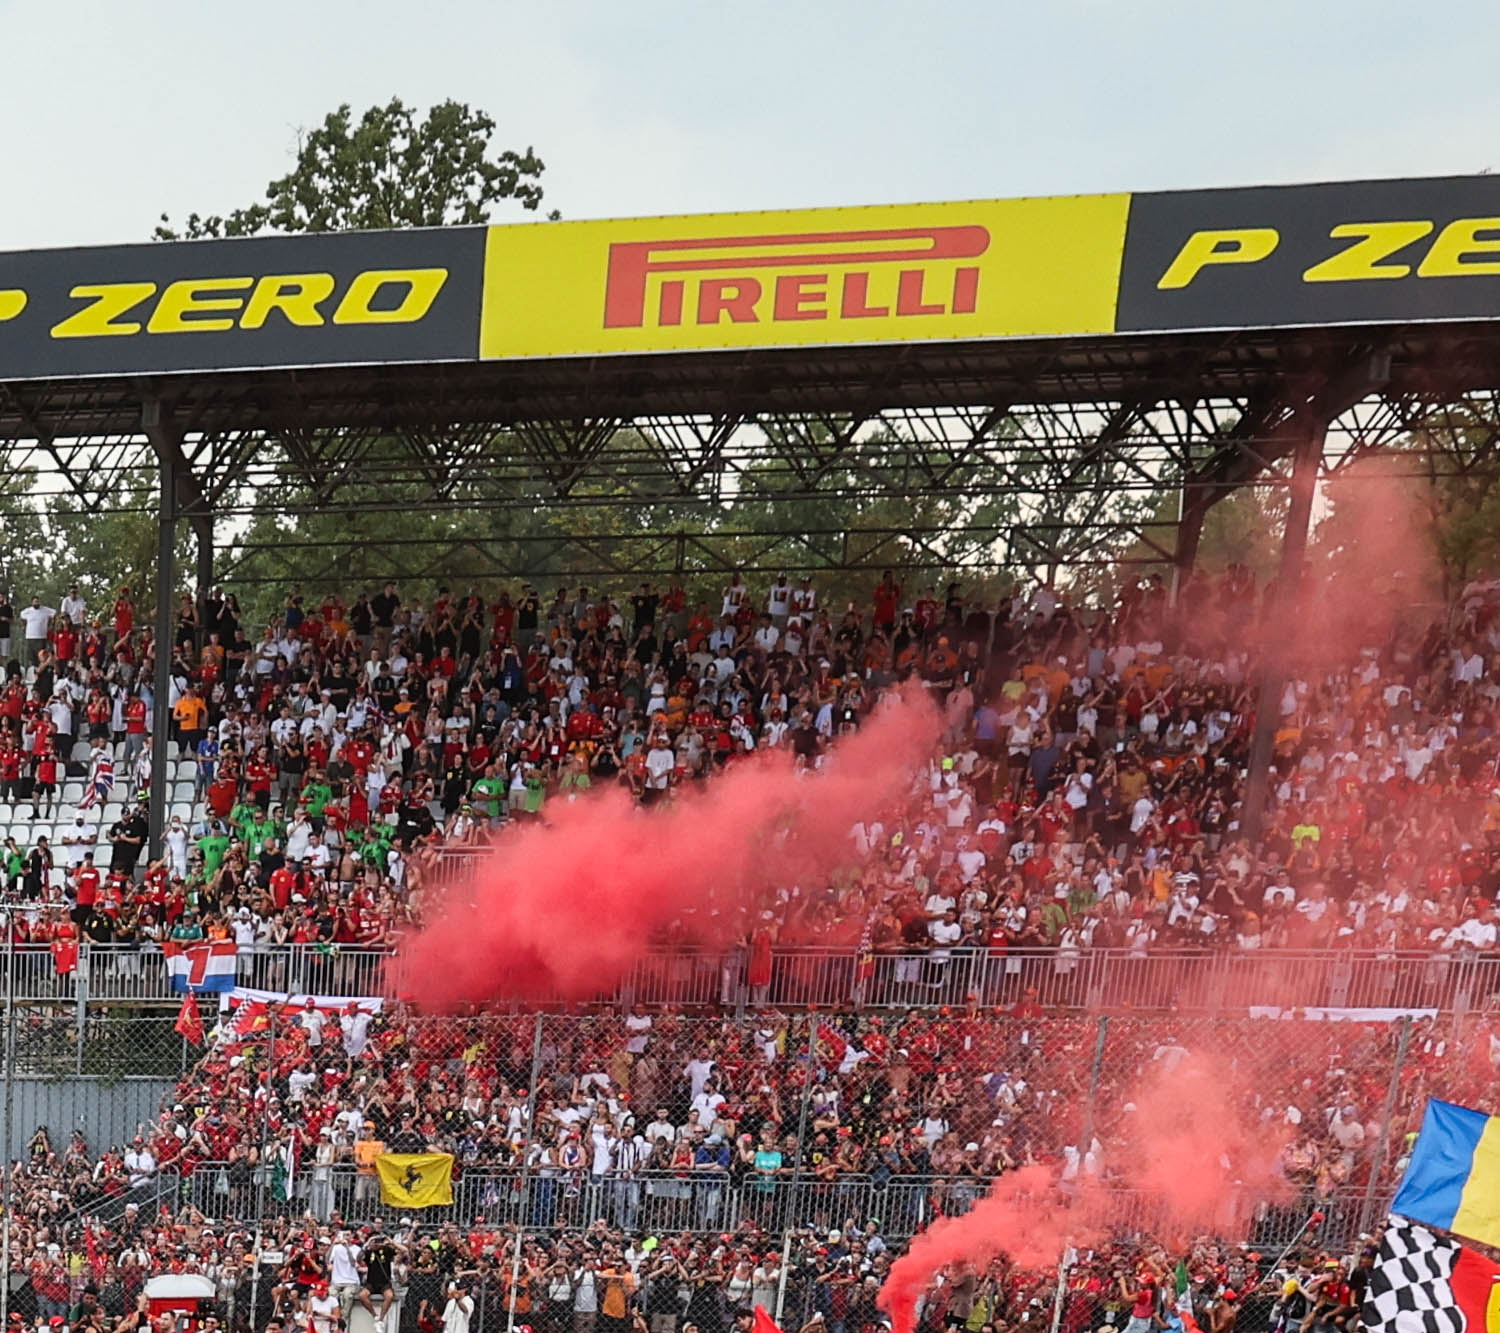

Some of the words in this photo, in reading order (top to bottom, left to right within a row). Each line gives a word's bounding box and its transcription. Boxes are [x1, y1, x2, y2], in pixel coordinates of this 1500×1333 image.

[602, 224, 991, 329] PIRELLI
[1157, 227, 1279, 291] P
[50, 268, 449, 339] ZERO
